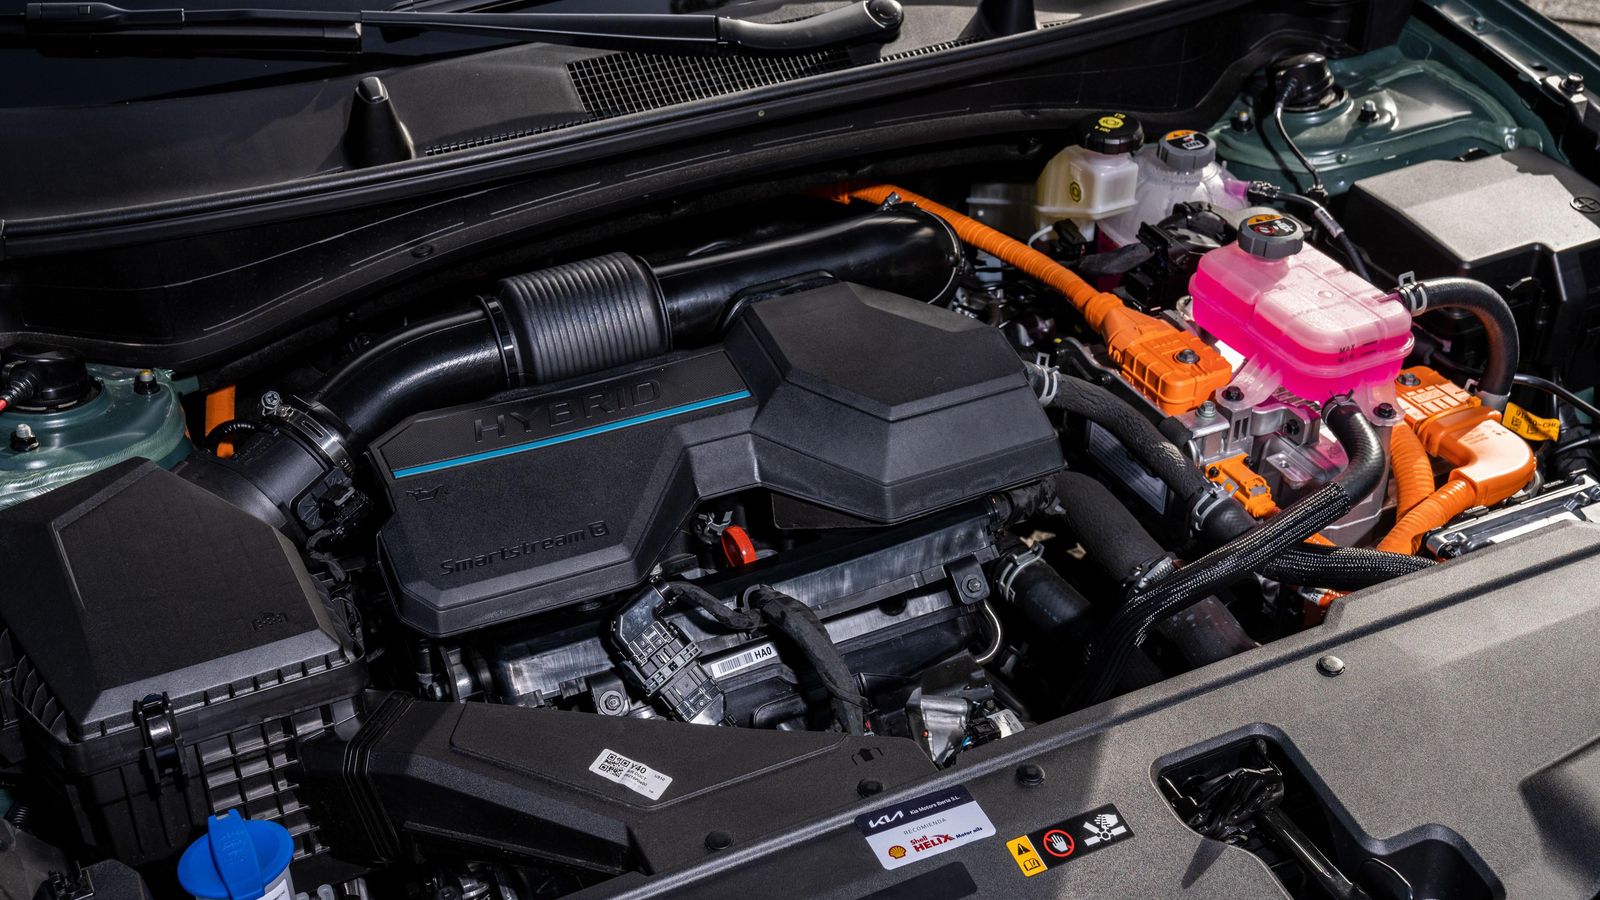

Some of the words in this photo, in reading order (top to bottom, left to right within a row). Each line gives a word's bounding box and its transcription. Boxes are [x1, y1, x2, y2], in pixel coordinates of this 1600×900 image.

[474, 380, 661, 442] HYBRID
[440, 528, 585, 576] Smartstream
[630, 763, 647, 774] Y40
[868, 810, 904, 829] KIA
[918, 803, 937, 812] Motors
[937, 798, 951, 807] Iberia
[903, 817, 947, 835] RECOMIENDA
[910, 835, 928, 845] Shell
[913, 834, 955, 852] HELIX
[955, 830, 972, 839] Motor
[973, 826, 983, 835] oils
